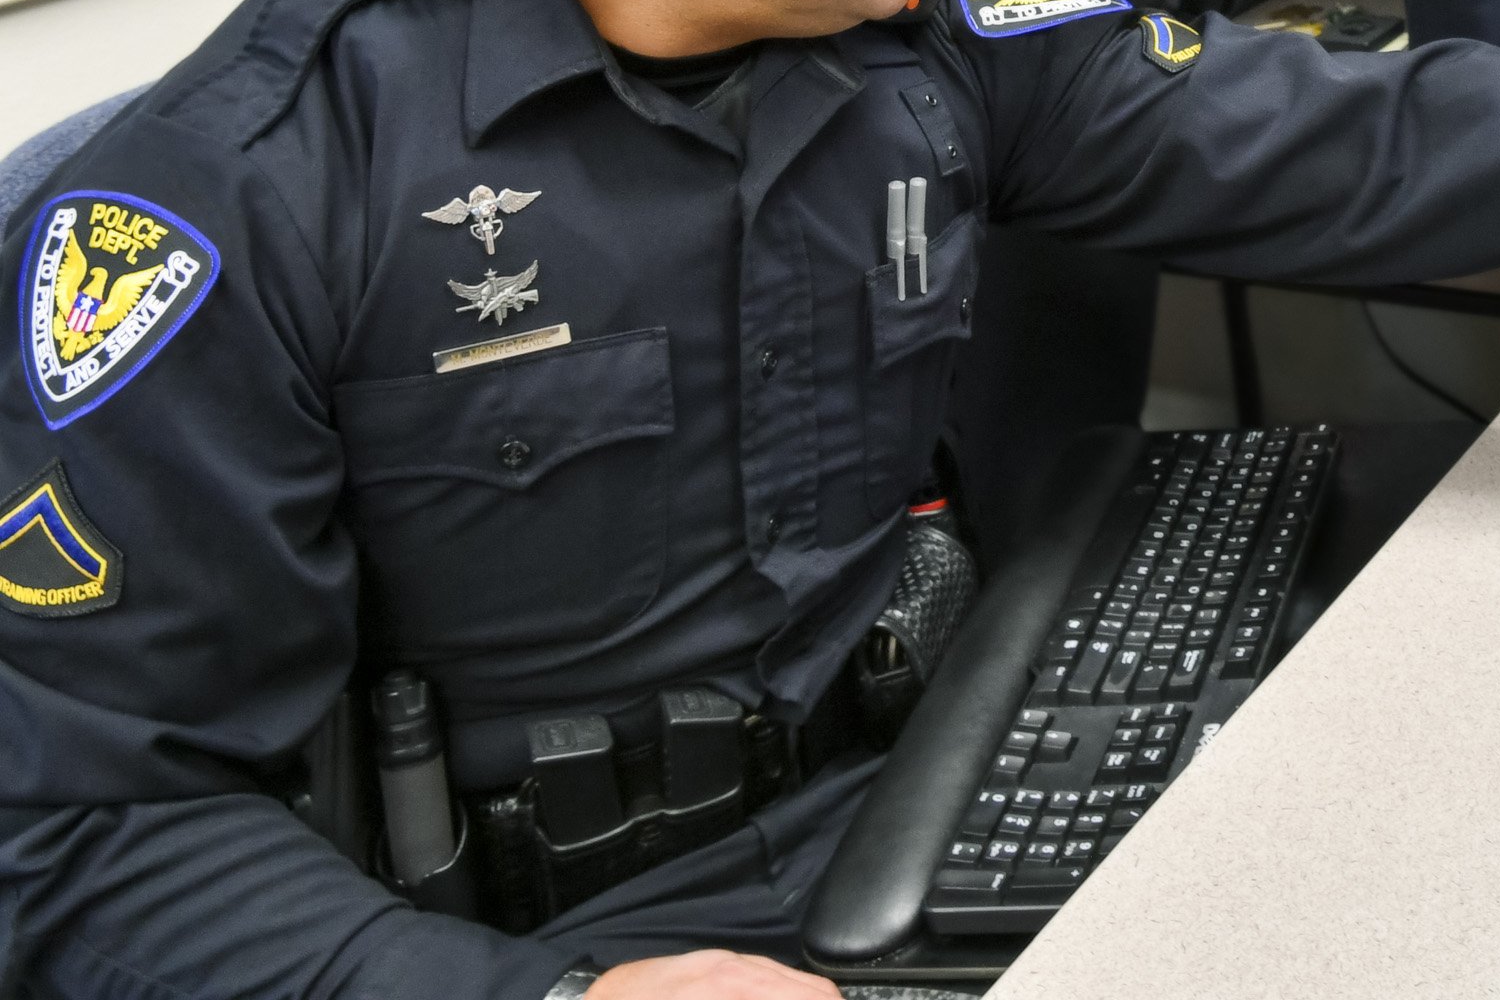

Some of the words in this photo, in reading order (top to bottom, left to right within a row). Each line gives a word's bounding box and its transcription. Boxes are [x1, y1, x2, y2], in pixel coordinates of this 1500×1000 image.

[89, 203, 169, 250] POLICE
[41, 249, 59, 281] TO
[37, 284, 60, 380] PROTECT
[105, 295, 165, 360] SERVE
[64, 357, 101, 393] AND
[47, 580, 105, 605] OFFICER
[1066, 792, 1079, 802] 4
[1102, 789, 1116, 798] 7
[1016, 817, 1031, 826] 2
[1053, 818, 1068, 827] 5
[1090, 815, 1104, 824] 8
[1003, 842, 1019, 854] 3
[1041, 844, 1056, 854] 6
[1078, 841, 1092, 851] 9
